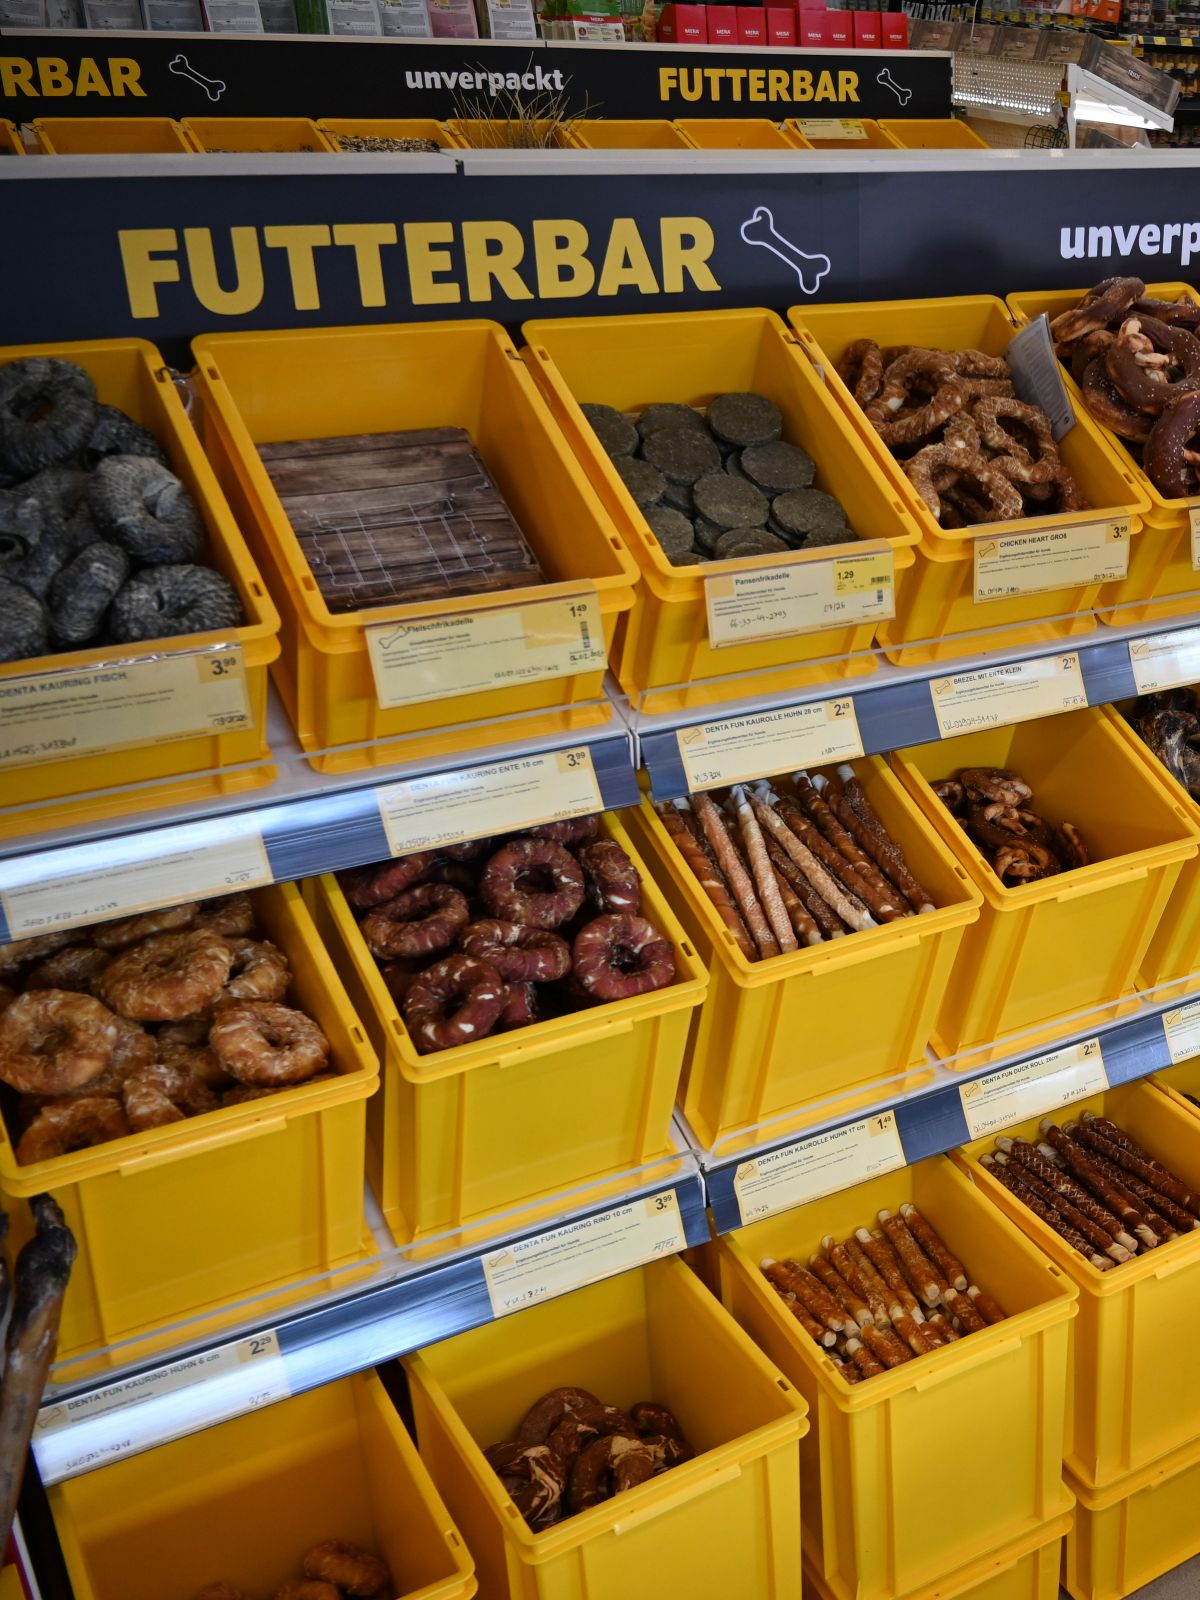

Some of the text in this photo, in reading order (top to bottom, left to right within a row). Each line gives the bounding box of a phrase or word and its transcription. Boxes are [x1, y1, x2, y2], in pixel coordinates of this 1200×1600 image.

[405, 66, 564, 96] unverpackt
[659, 67, 860, 102] FUTTERBAR
[118, 216, 722, 319] FUTTERBAR
[1000, 538, 1027, 548] CHICKEN
[1028, 535, 1049, 544] HEART
[735, 572, 790, 586] Pansenfrikadelle
[837, 570, 854, 581] 1,29
[406, 617, 474, 633] Fleischfrikadelle
[212, 656, 237, 676] 3.99
[953, 666, 1022, 685] BREZEL MIT ENTE KLEIN
[39, 677, 91, 693] KAURING
[94, 671, 127, 685] FISCH
[705, 722, 729, 734] DENTA
[730, 719, 744, 729] FUN
[745, 712, 783, 727] KAUROLLE
[784, 710, 803, 720] HUHN
[459, 767, 498, 782] KAURING
[499, 762, 521, 774] ENTE
[522, 761, 531, 770] 10
[532, 759, 544, 767] cm
[566, 751, 586, 768] 3.99
[981, 1075, 1001, 1086] DENTA
[1001, 1070, 1013, 1079] FUN
[1013, 1064, 1030, 1075] DUCK
[1030, 1059, 1045, 1069] ROLL
[758, 1155, 780, 1167] DENTA
[780, 1149, 794, 1159] FUN
[794, 1136, 829, 1153] KAUROLLE
[830, 1130, 848, 1140] HUHN
[655, 1194, 673, 1211] 3.99
[513, 1239, 540, 1254] DENTA
[540, 1232, 557, 1243] FUN
[557, 1220, 592, 1237] KAURING
[592, 1214, 611, 1225] RIND
[622, 1207, 633, 1215] cm
[67, 1393, 101, 1410] DENTA
[102, 1386, 124, 1398] FUN
[124, 1369, 169, 1390] KAURING
[169, 1360, 198, 1374] HUHN
[206, 1353, 220, 1362] cm
